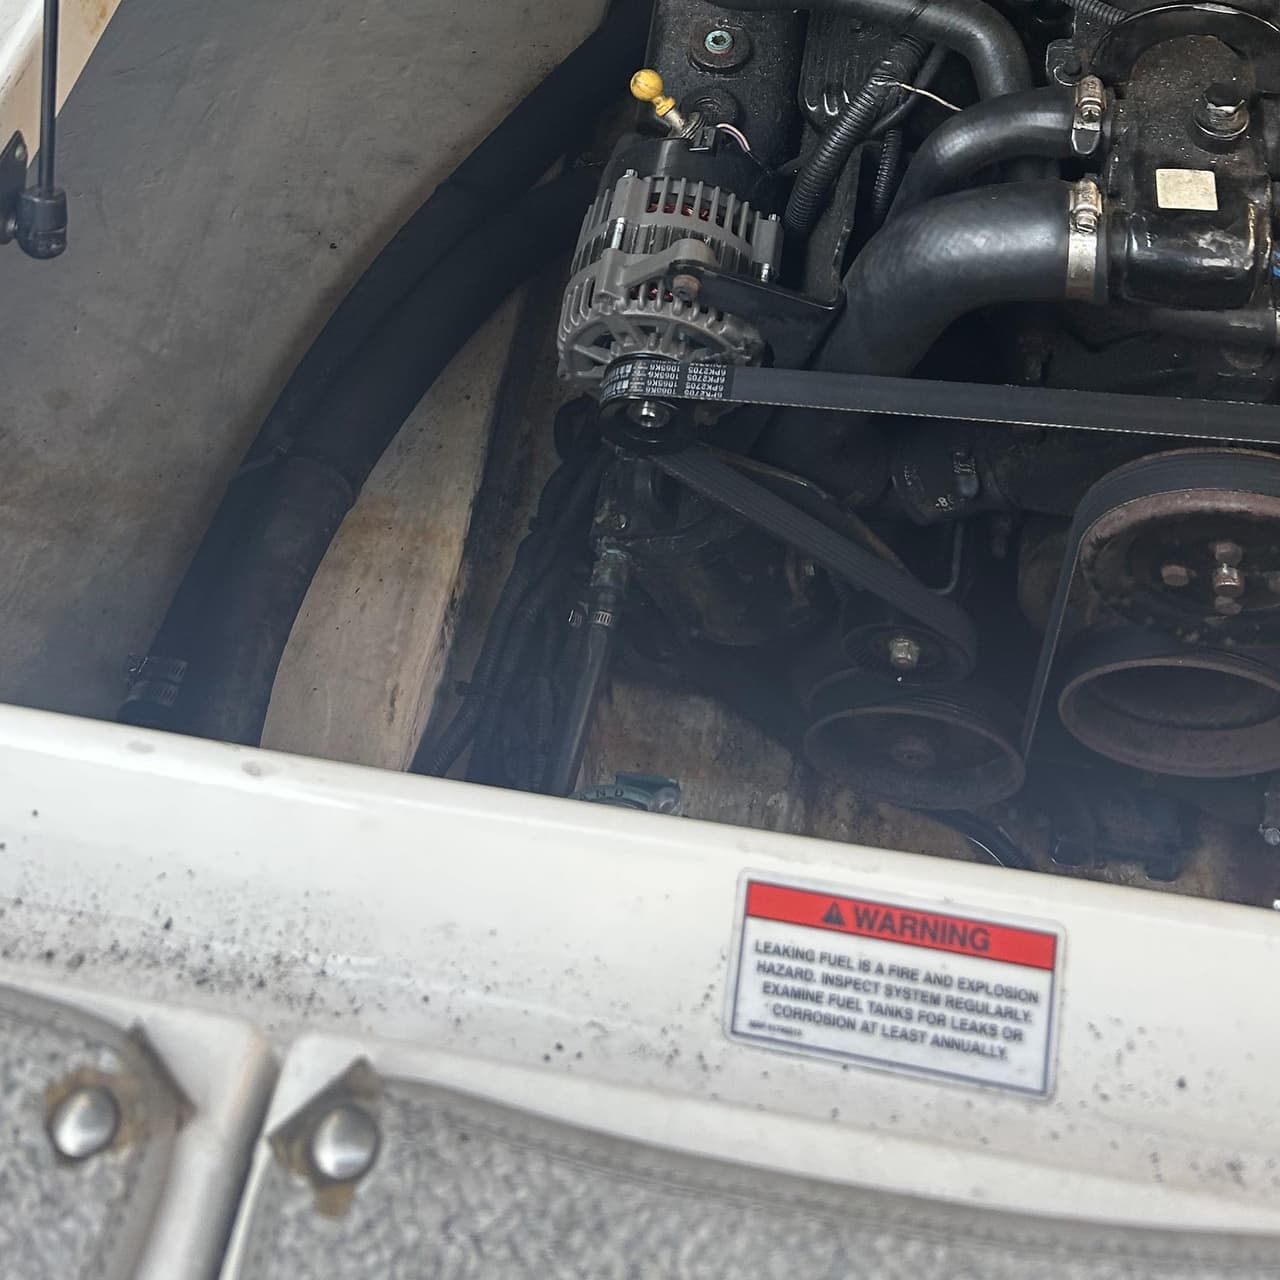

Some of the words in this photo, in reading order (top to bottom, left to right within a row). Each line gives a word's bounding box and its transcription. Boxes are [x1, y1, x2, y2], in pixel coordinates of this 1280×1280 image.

[853, 903, 991, 953] WARNING
[754, 939, 816, 963] LEAKING
[820, 951, 854, 970] FUEL
[858, 959, 871, 971] IS
[874, 962, 885, 975] A
[888, 964, 920, 982] FIRE
[923, 972, 954, 988] AND
[957, 977, 1039, 1004] EXPLOSION
[756, 959, 817, 983] HAZARD.
[821, 972, 881, 995] INSPECT
[884, 983, 942, 1006] SYSTEM
[945, 994, 1032, 1024] REGULARLY.
[762, 980, 826, 1004] EXAMINE
[828, 993, 864, 1012] FUEL
[869, 999, 914, 1021] TANKS
[917, 1009, 947, 1027] FOR
[950, 1015, 999, 1038] LEAKS
[1002, 1025, 1024, 1042] OR
[772, 1003, 857, 1031] CORROSION
[860, 1019, 878, 1034] AT
[881, 1023, 928, 1044] LEAST
[929, 1033, 1009, 1062] ANNUALLY.
